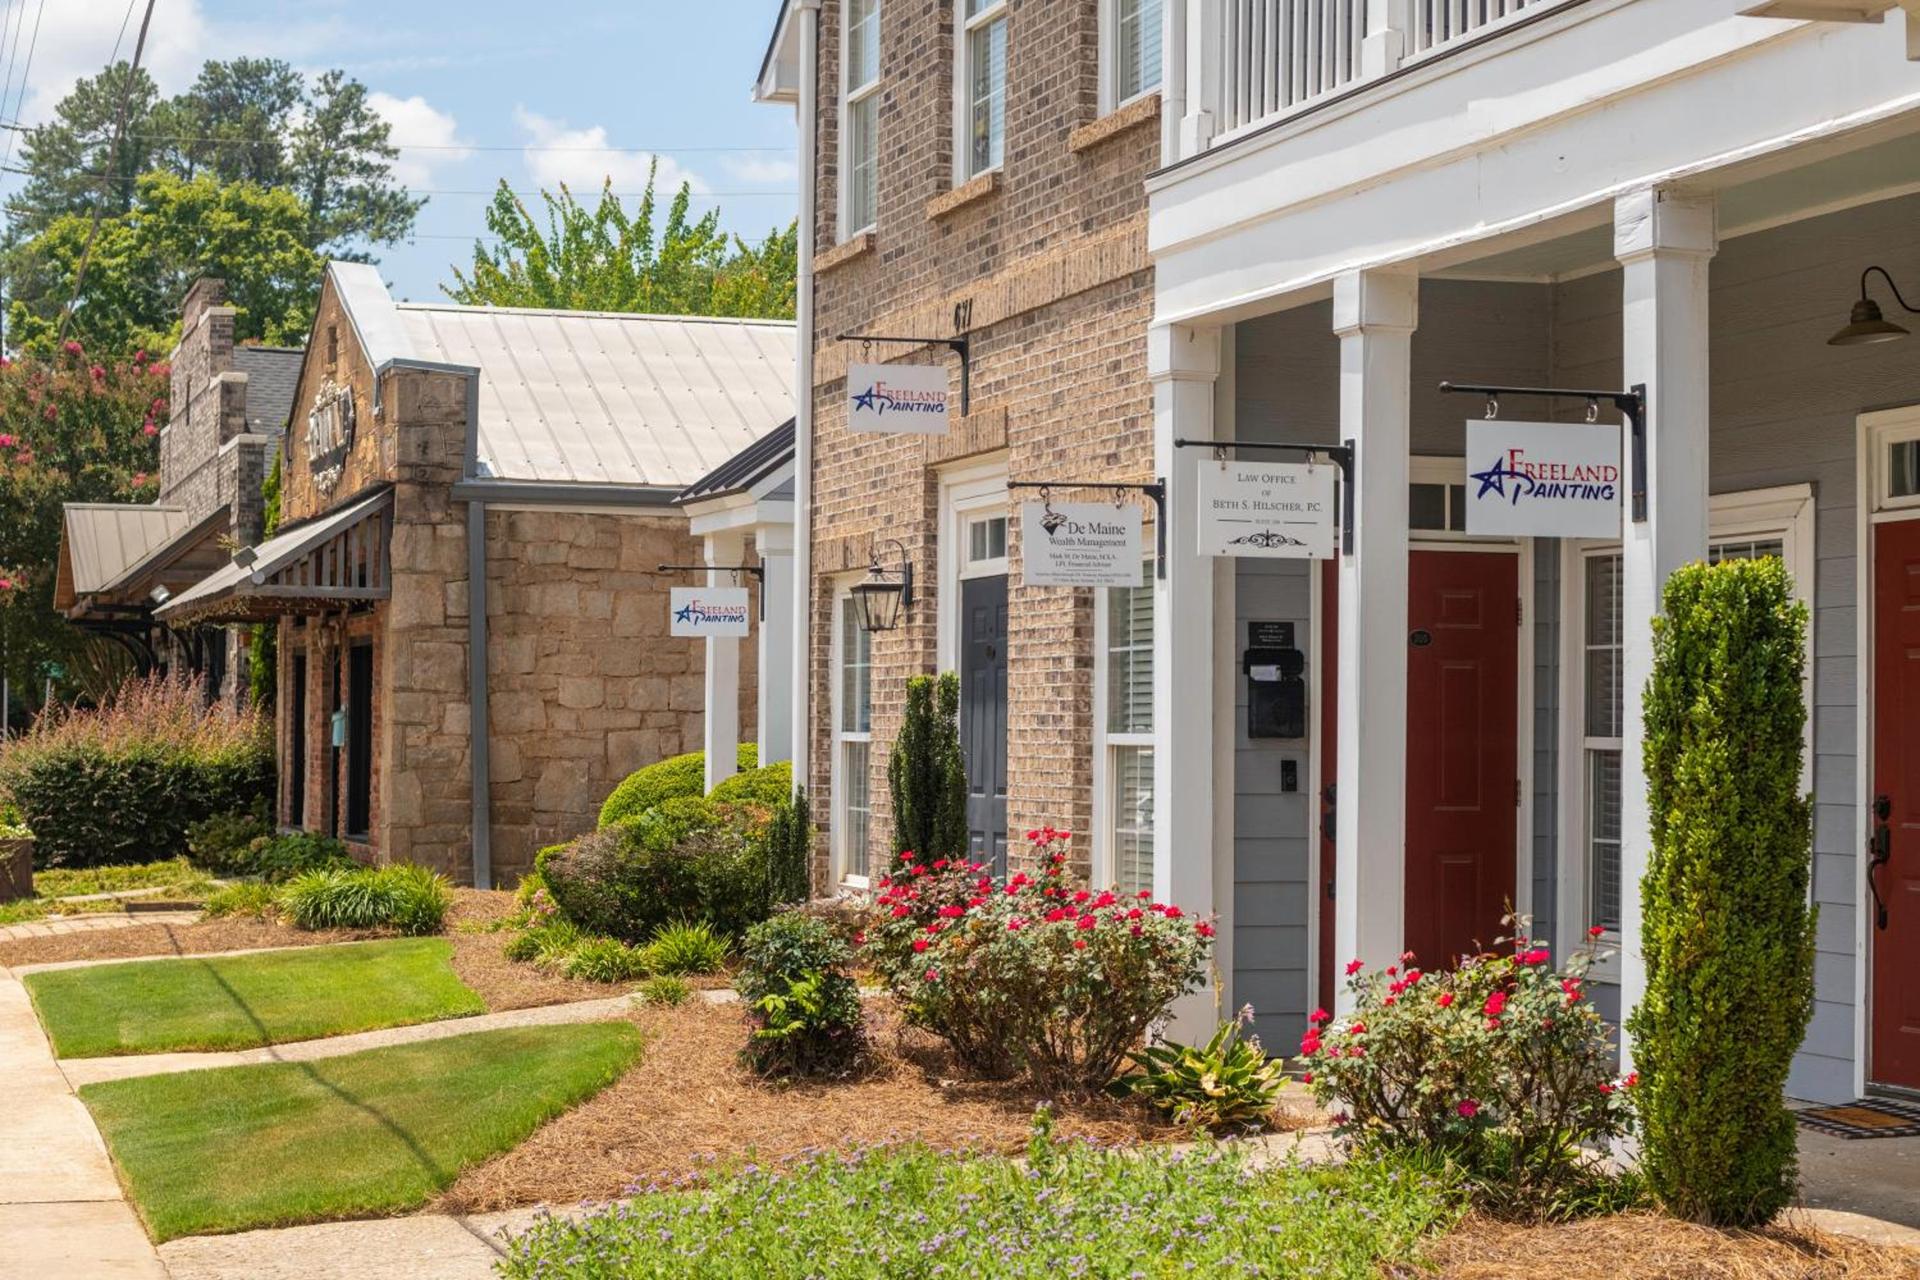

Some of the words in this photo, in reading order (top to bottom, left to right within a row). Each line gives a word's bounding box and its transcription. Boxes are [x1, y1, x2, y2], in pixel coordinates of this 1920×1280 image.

[876, 381, 947, 403] FREELAND
[878, 395, 945, 416] PAINTING
[1507, 448, 1618, 482] FREELAND
[1237, 473, 1259, 482] LAW
[1261, 473, 1296, 484] OFFICE
[1511, 471, 1615, 506] PAINTING
[1212, 499, 1239, 509] BETH
[1241, 500, 1250, 510] S.
[1253, 501, 1303, 512] HILSCHER,
[1067, 521, 1086, 535] De
[1089, 522, 1127, 535] Maine
[1048, 537, 1076, 546] Wealth
[1077, 538, 1127, 549] Management
[694, 610, 745, 626] PAINTING
